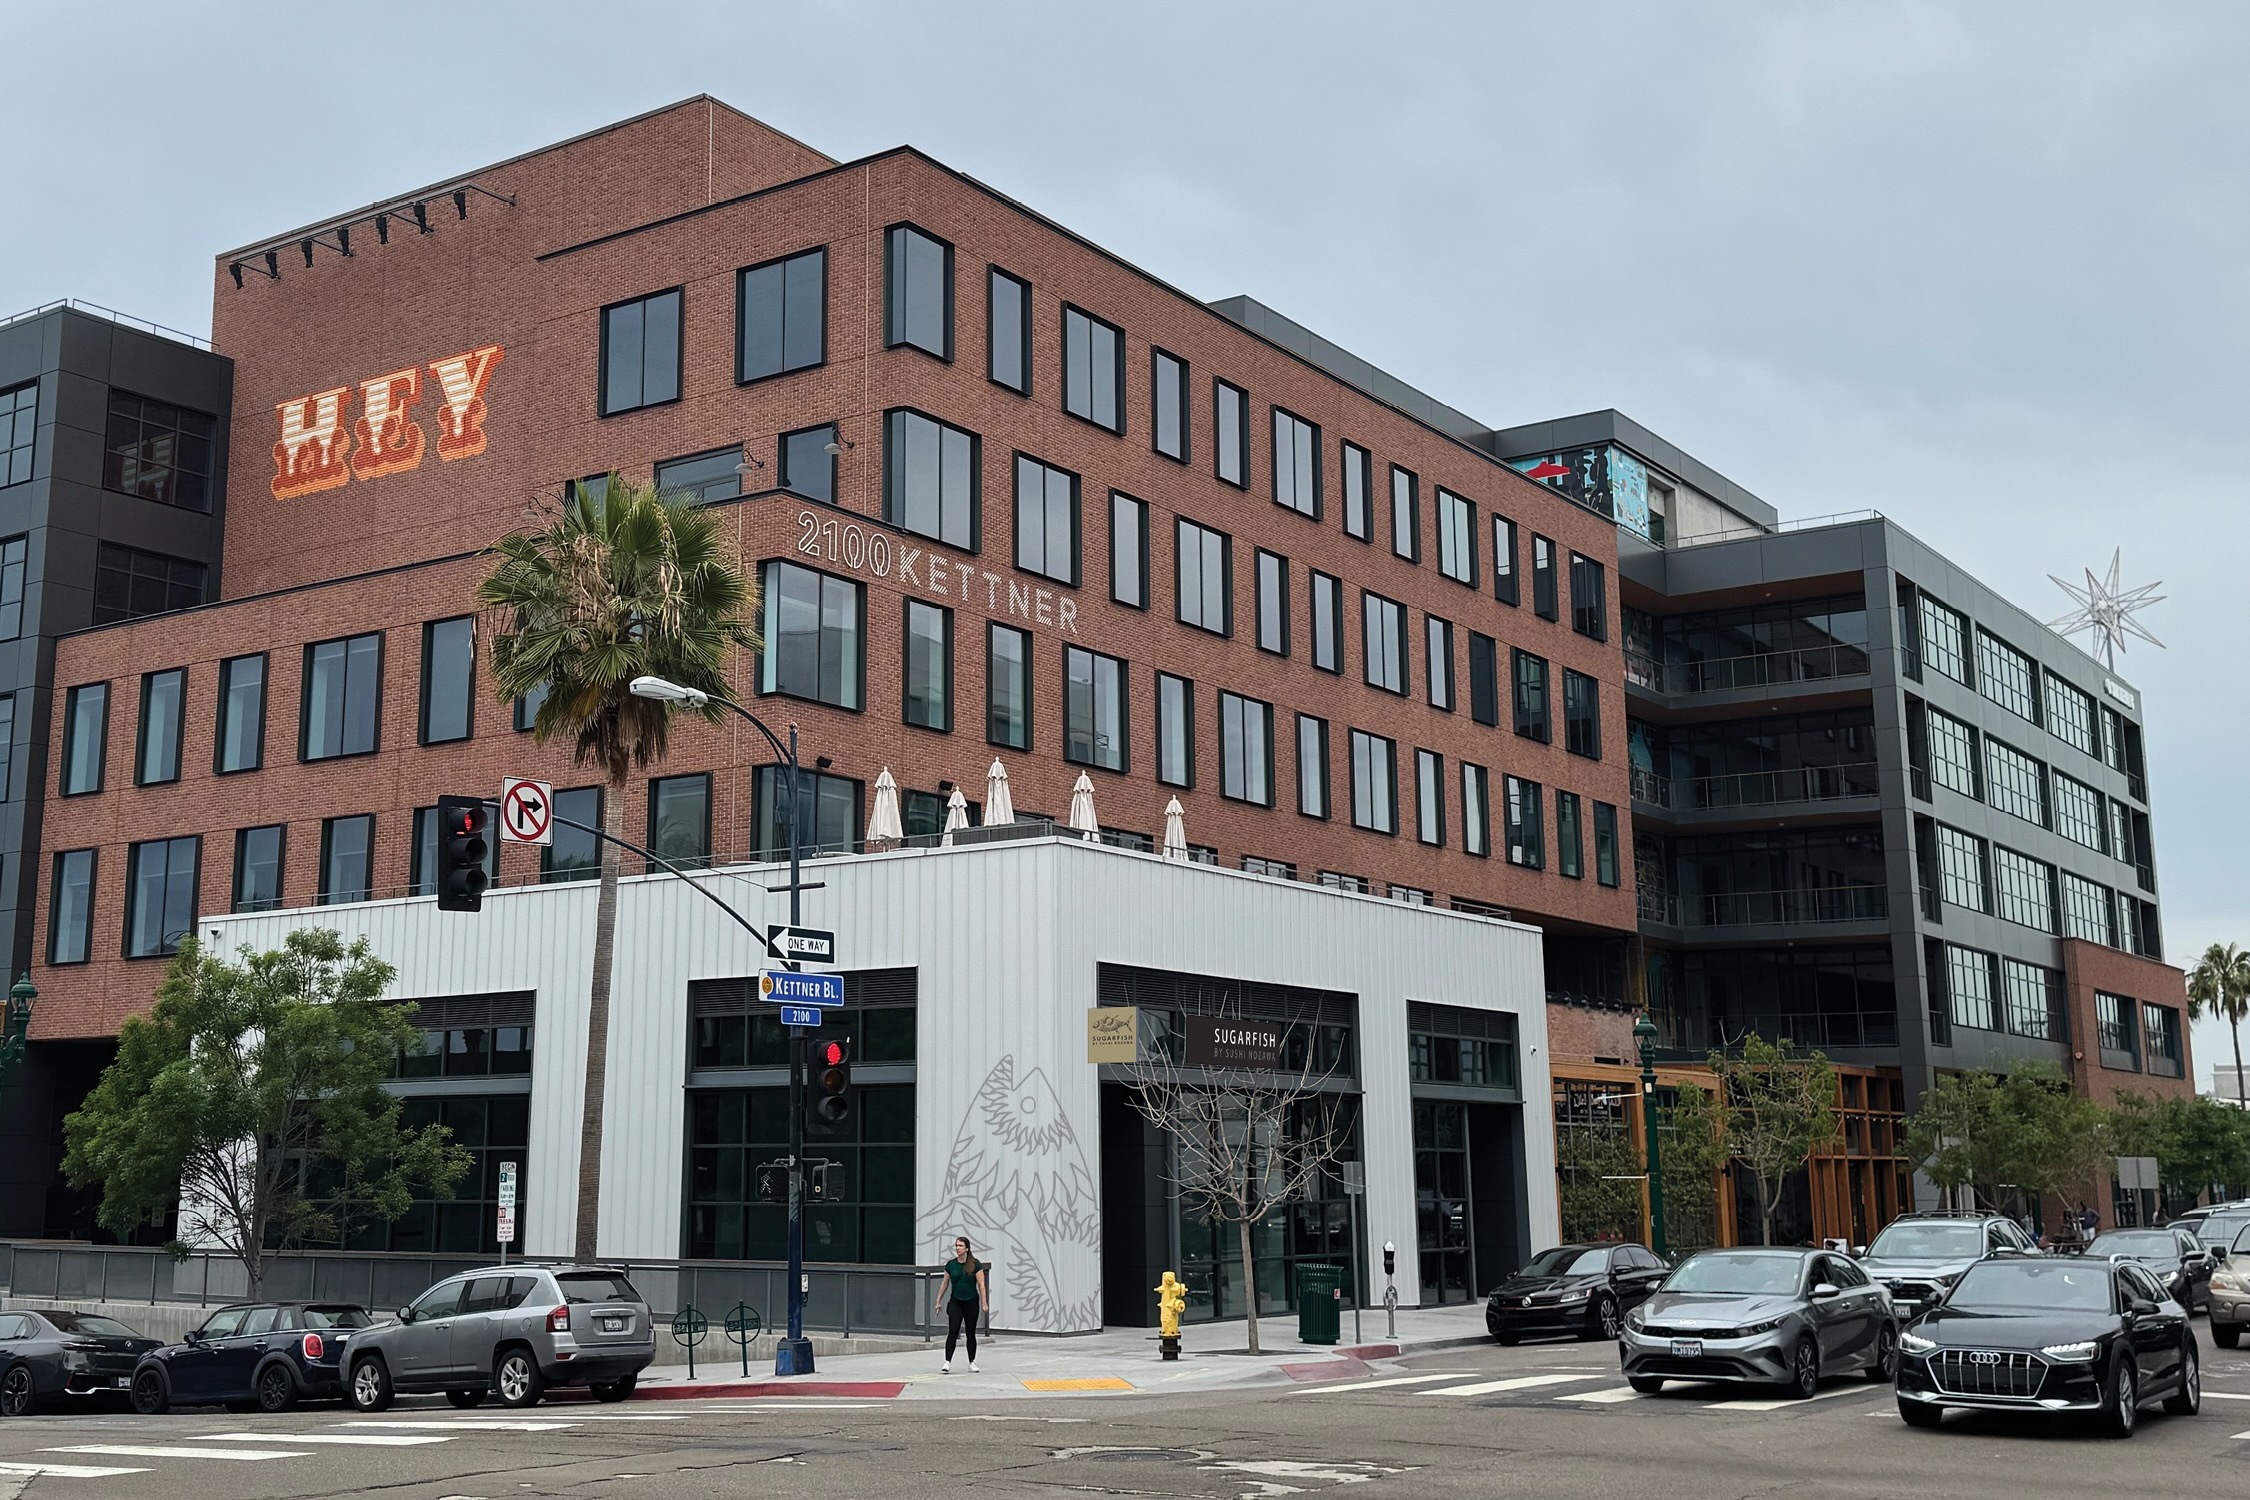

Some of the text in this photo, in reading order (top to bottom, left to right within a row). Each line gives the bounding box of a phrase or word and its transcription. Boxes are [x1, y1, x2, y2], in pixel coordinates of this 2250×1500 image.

[271, 343, 505, 500] HEY
[798, 511, 1078, 635] 2100 KETTNER
[788, 938, 825, 952] ONE WAY
[793, 1010, 810, 1022] 2100
[1214, 1028, 1276, 1048] SUGARFISH
[1214, 1048, 1276, 1061] BY SUSHI NOZAWA
